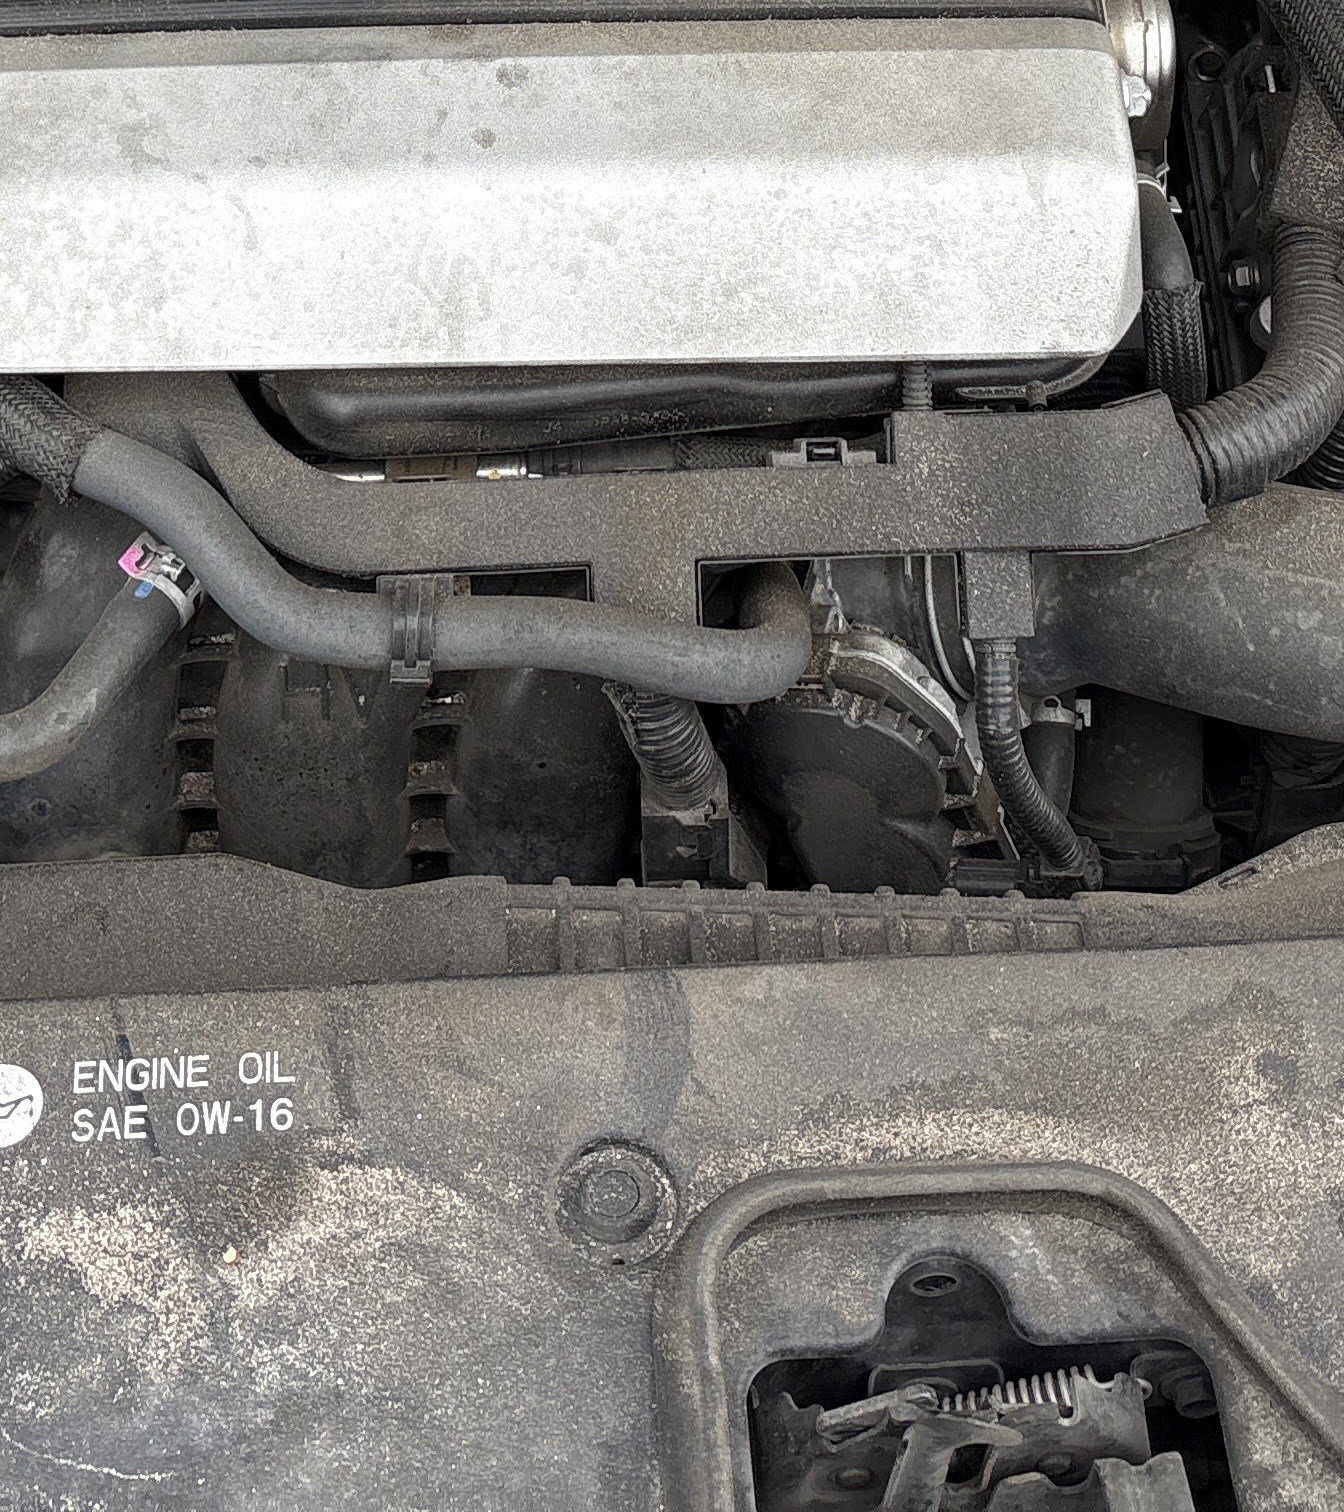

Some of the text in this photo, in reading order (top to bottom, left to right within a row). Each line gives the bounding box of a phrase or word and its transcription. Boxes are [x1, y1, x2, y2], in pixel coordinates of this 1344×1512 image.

[73, 1050, 296, 1094] ENGINE OIL
[71, 1097, 294, 1142] SAE 0W-16
